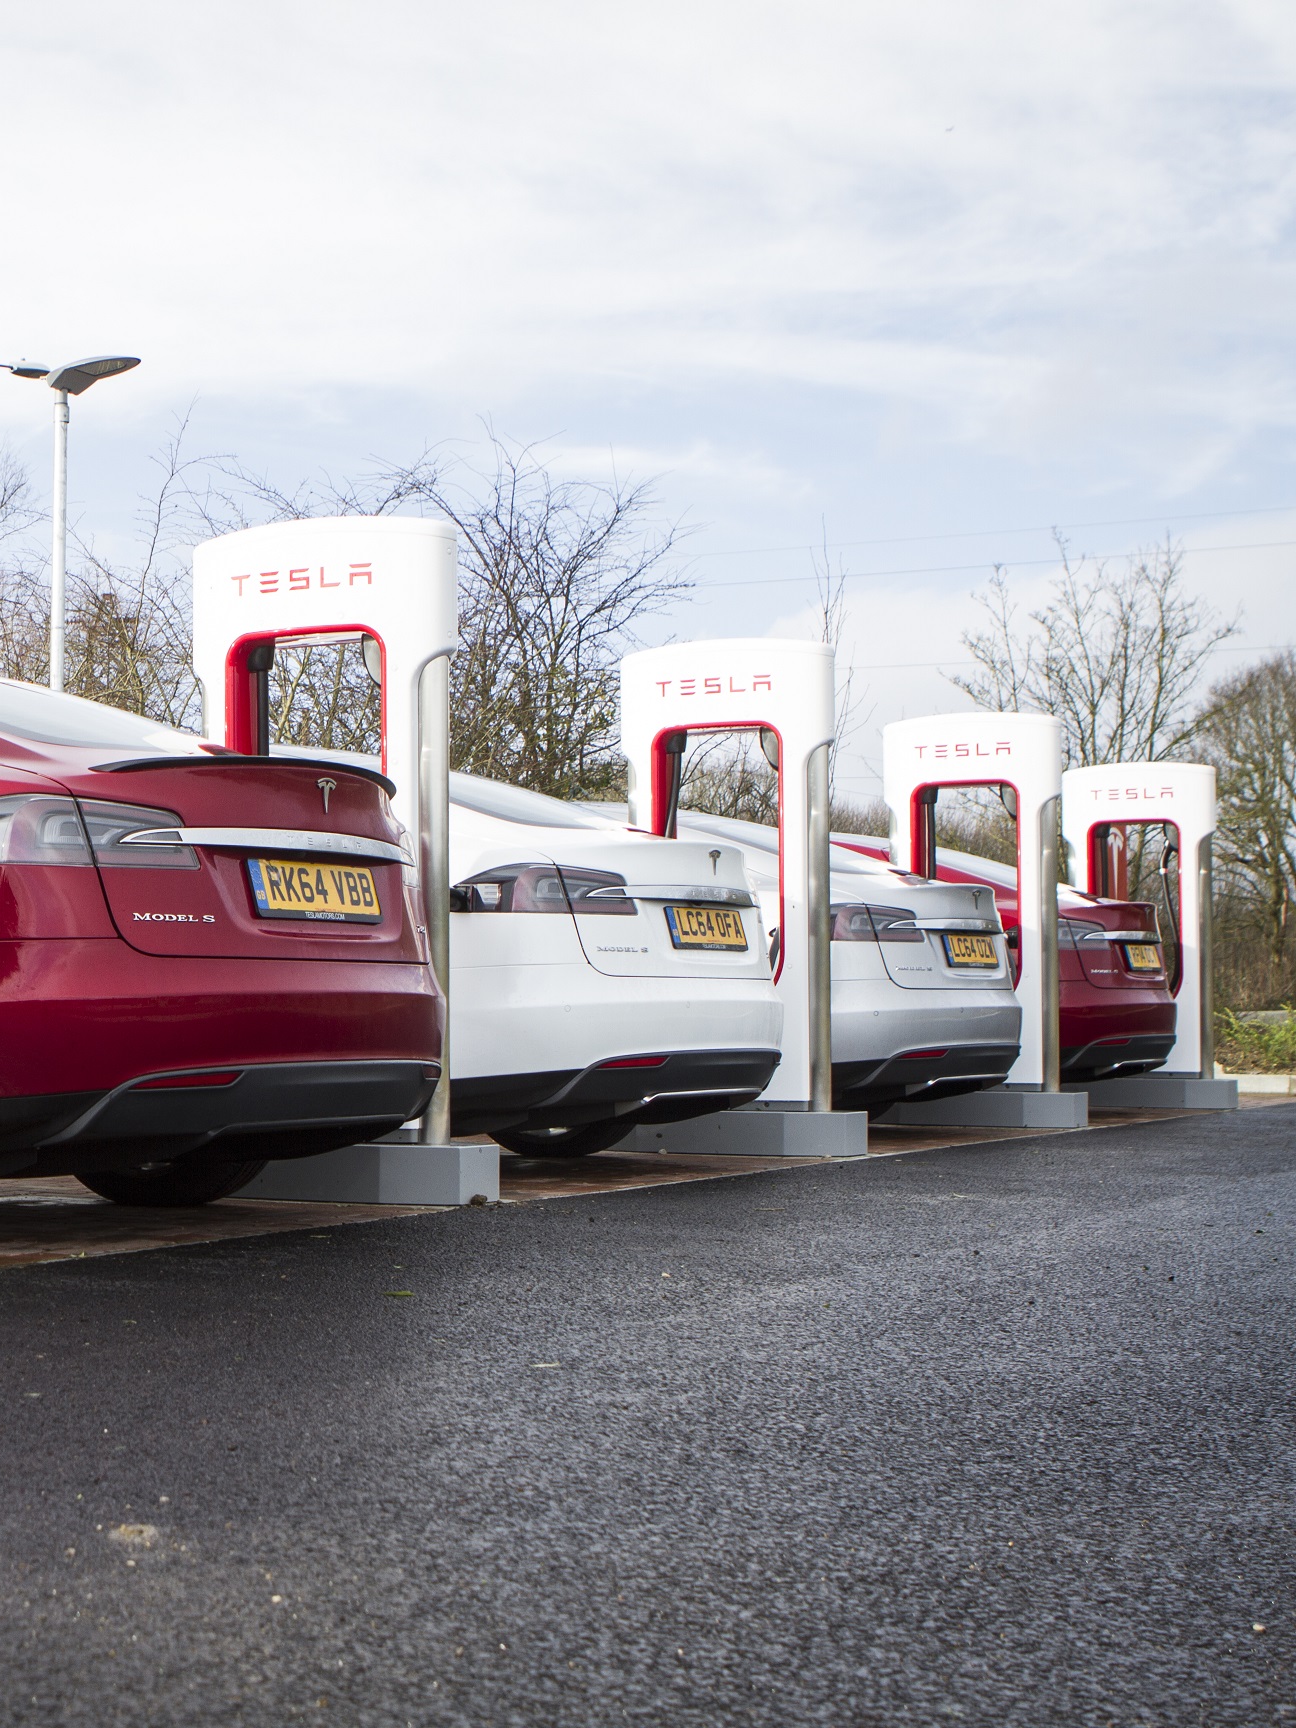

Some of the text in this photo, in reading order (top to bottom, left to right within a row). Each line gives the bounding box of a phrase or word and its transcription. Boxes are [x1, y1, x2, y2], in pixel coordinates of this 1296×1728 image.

[231, 562, 372, 597] TESLA
[656, 674, 771, 697] TESLA
[914, 741, 1011, 759] TESLA
[1090, 787, 1173, 800] TESLA
[265, 864, 374, 908] RK64 VBB
[132, 912, 216, 923] MODEL S
[304, 911, 346, 920] TESLAMOTORS.COM
[675, 909, 715, 938] LC64
[950, 937, 977, 958] LC64
